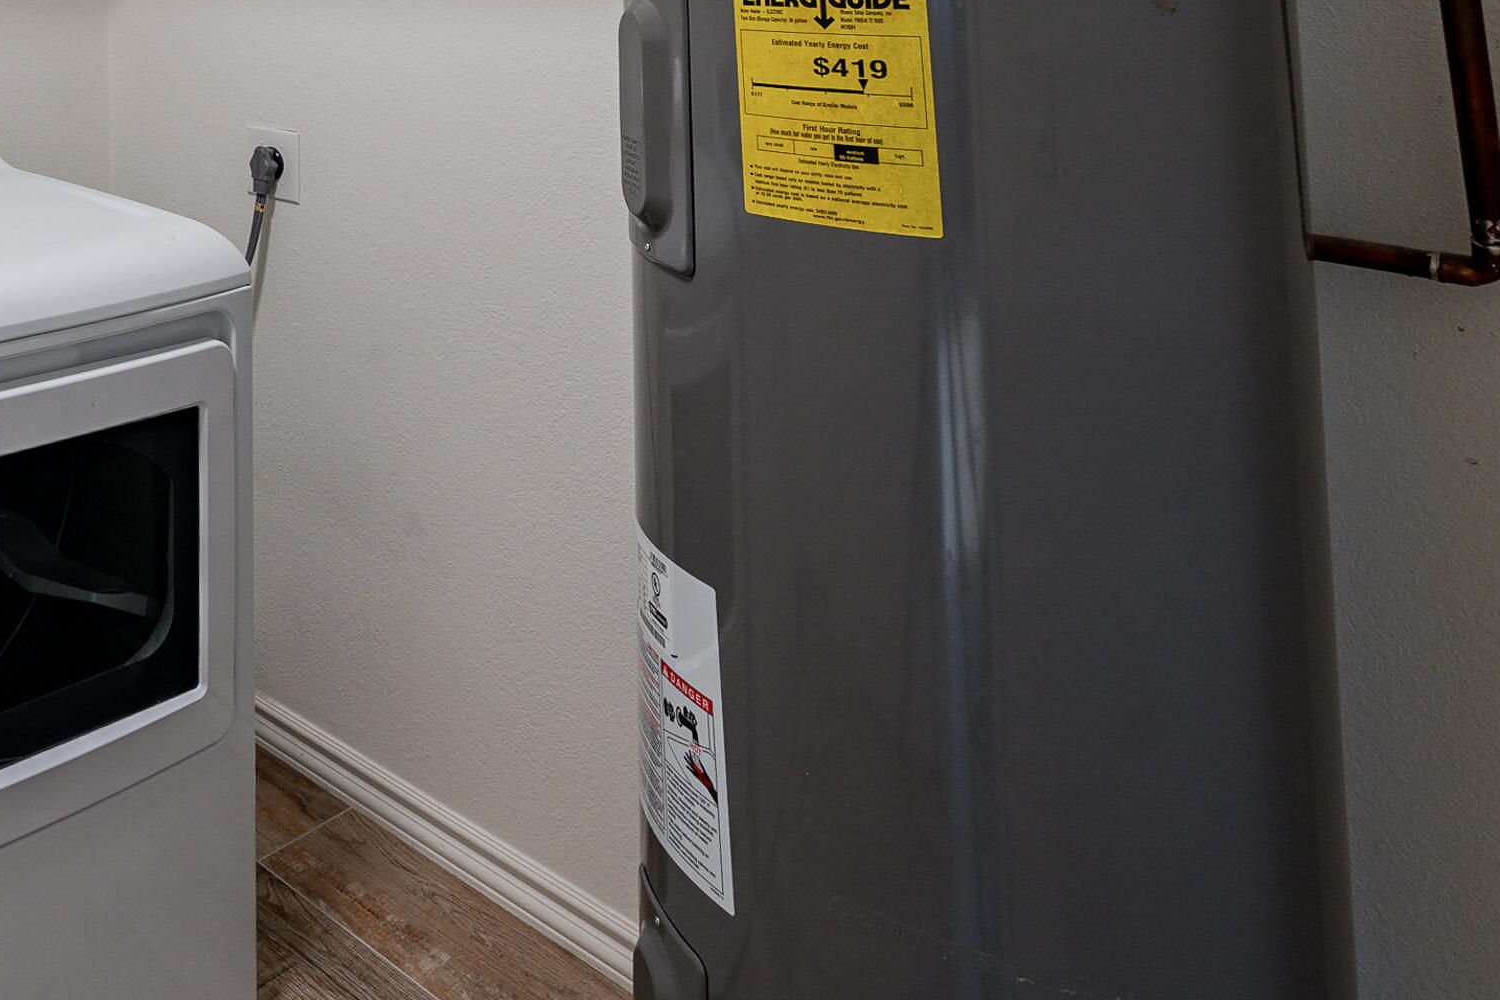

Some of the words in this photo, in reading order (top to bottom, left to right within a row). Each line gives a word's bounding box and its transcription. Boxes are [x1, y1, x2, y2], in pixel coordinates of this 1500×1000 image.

[771, 39, 802, 47] Estimated
[804, 40, 825, 49] Yearly
[827, 41, 851, 50] Energy
[853, 42, 869, 50] Cost
[813, 56, 887, 79] $419
[802, 123, 817, 132] First
[819, 125, 836, 133] Hour
[838, 127, 861, 136] Rating
[670, 673, 709, 711] DANGER
